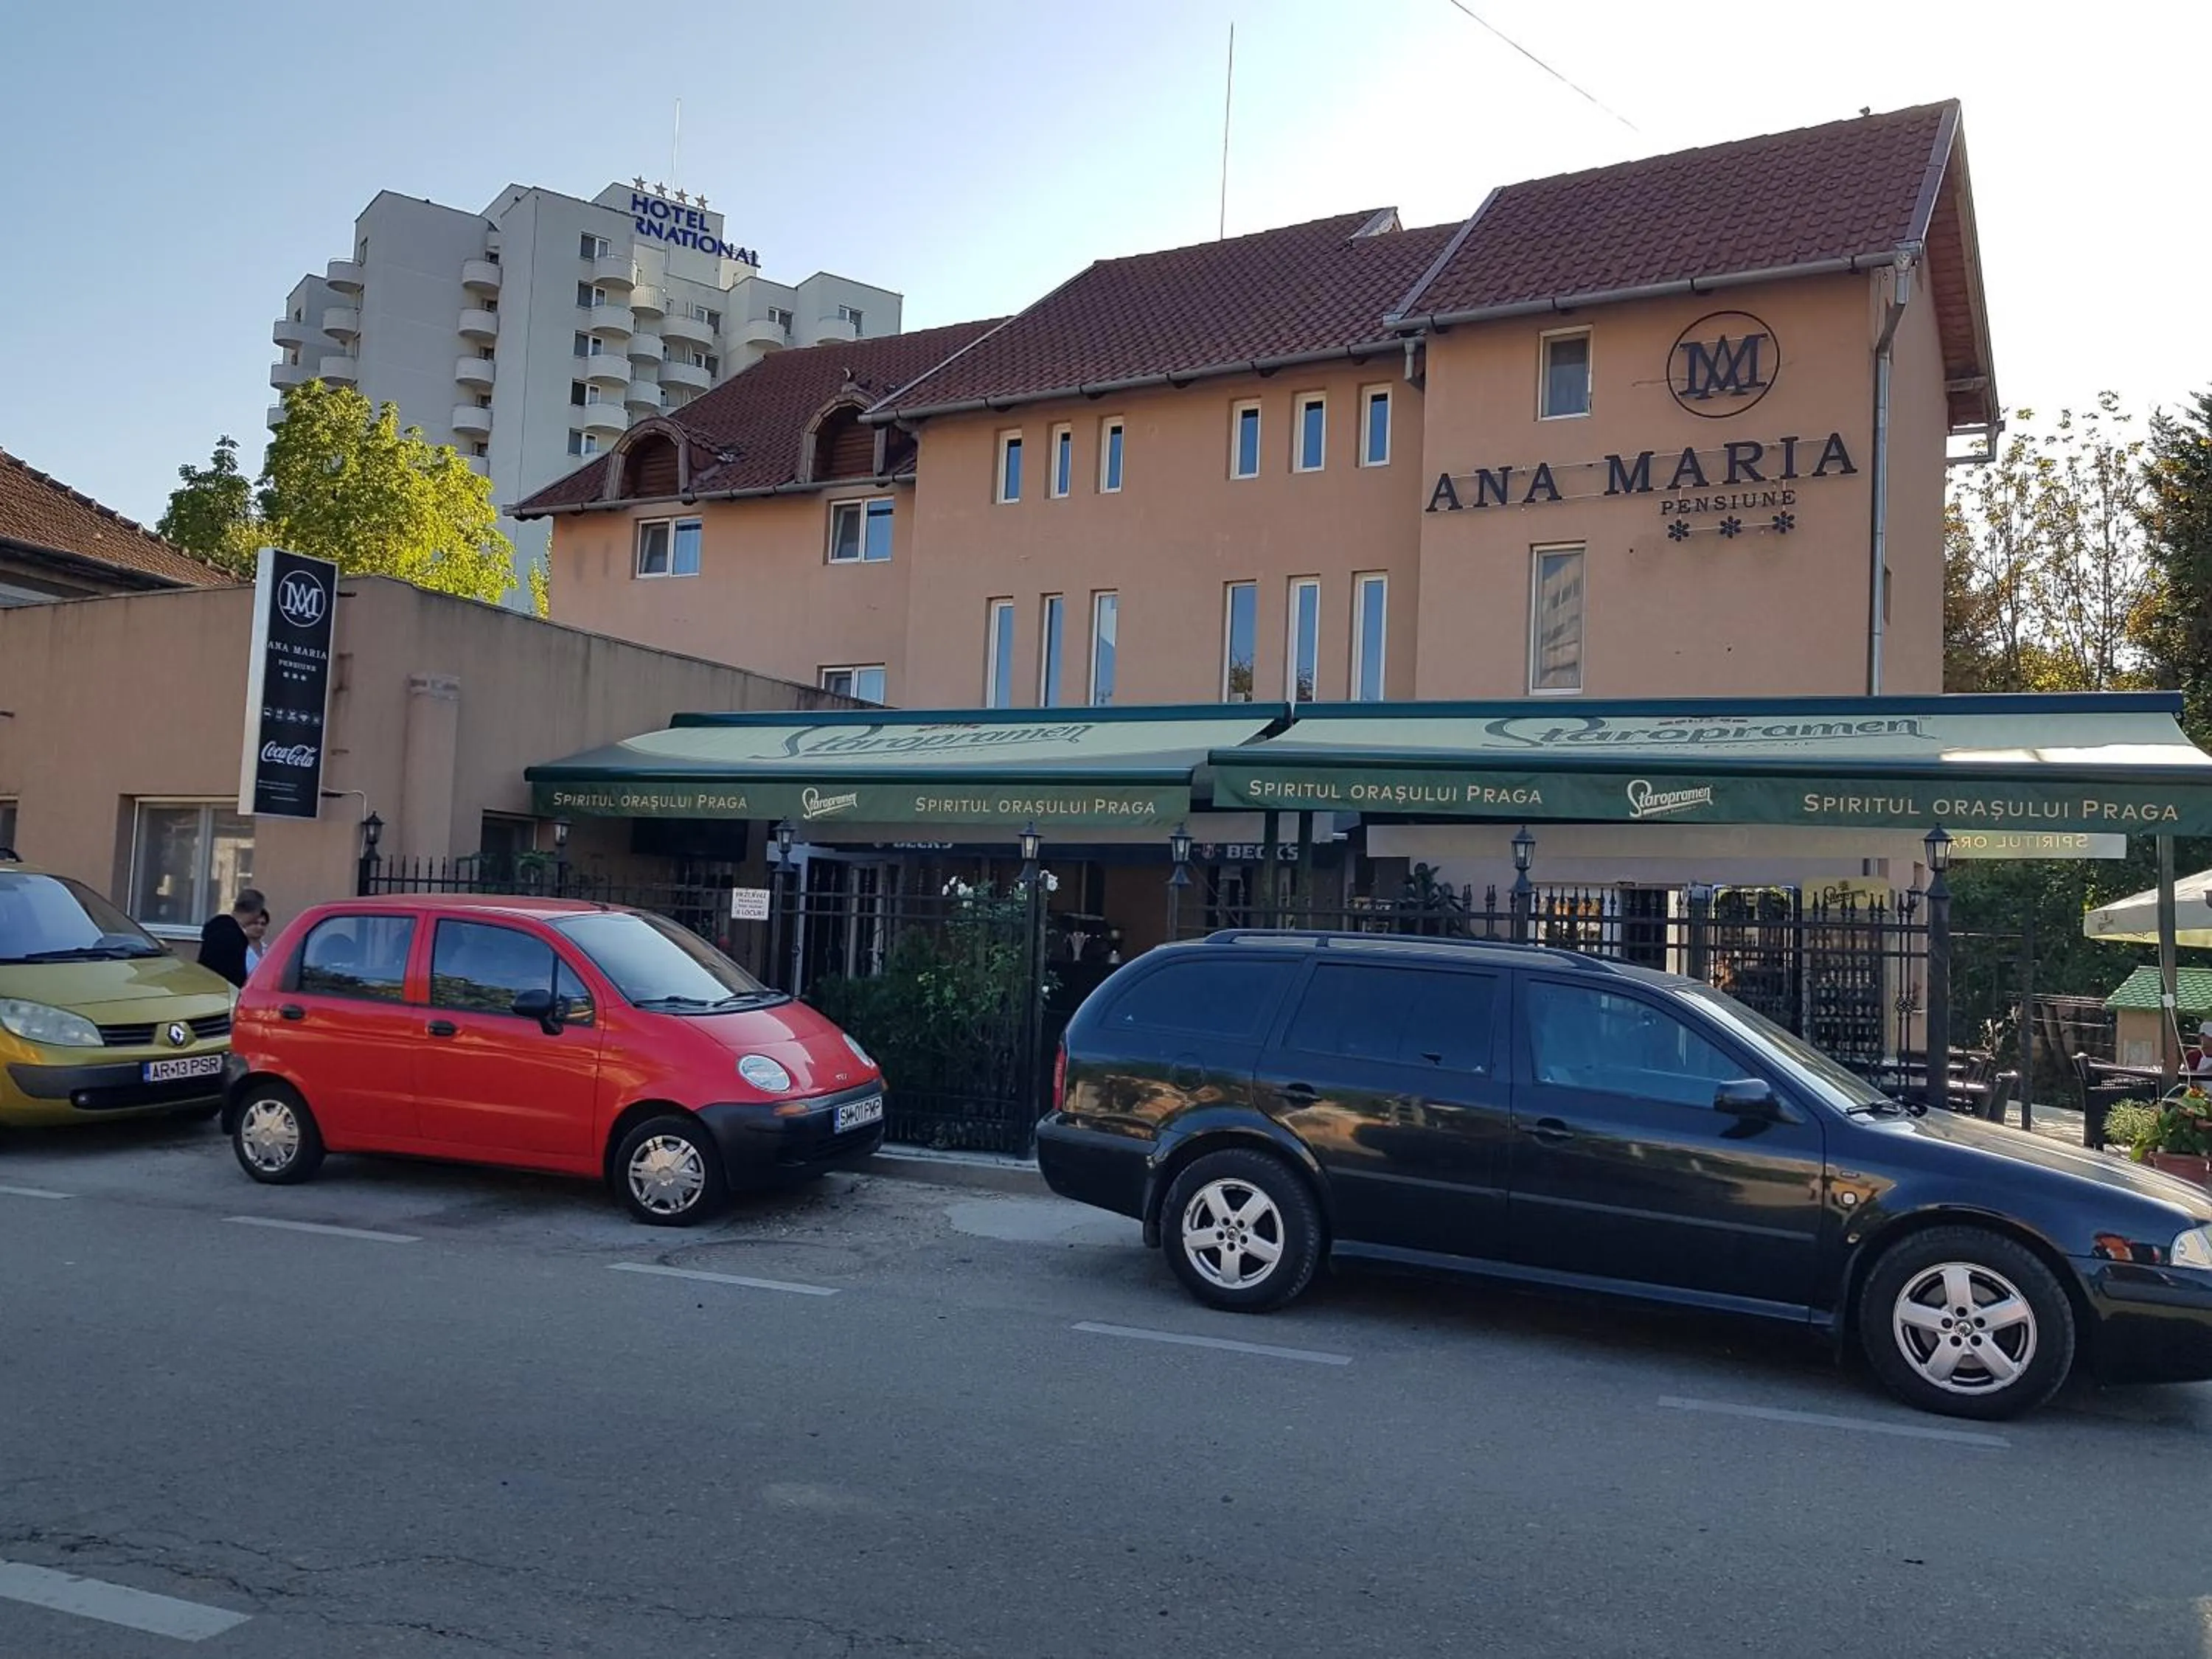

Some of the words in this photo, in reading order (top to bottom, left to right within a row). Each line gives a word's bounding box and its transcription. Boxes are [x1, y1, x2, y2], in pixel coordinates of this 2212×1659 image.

[631, 193, 709, 232] HOTEL
[1425, 462, 1562, 512] ANA
[1604, 432, 1858, 496] MARIA
[1660, 489, 1797, 515] PENSIUNE
[268, 640, 289, 653] ANA
[292, 644, 327, 660] MARIA
[748, 723, 1094, 760] Staropramen
[1481, 717, 1937, 748] Staropramen
[553, 792, 616, 807] SPIRITUL
[697, 794, 748, 810] PRAGA
[915, 796, 990, 813] SPIRITUL
[1094, 798, 1155, 815] PRAGA
[1249, 779, 1340, 799] SPIRITUL
[1466, 785, 1543, 804] PRAGA
[1627, 779, 1714, 818] Staropramen
[1804, 793, 1920, 815] SPIRITUL
[2081, 799, 2180, 821] PRAGA
